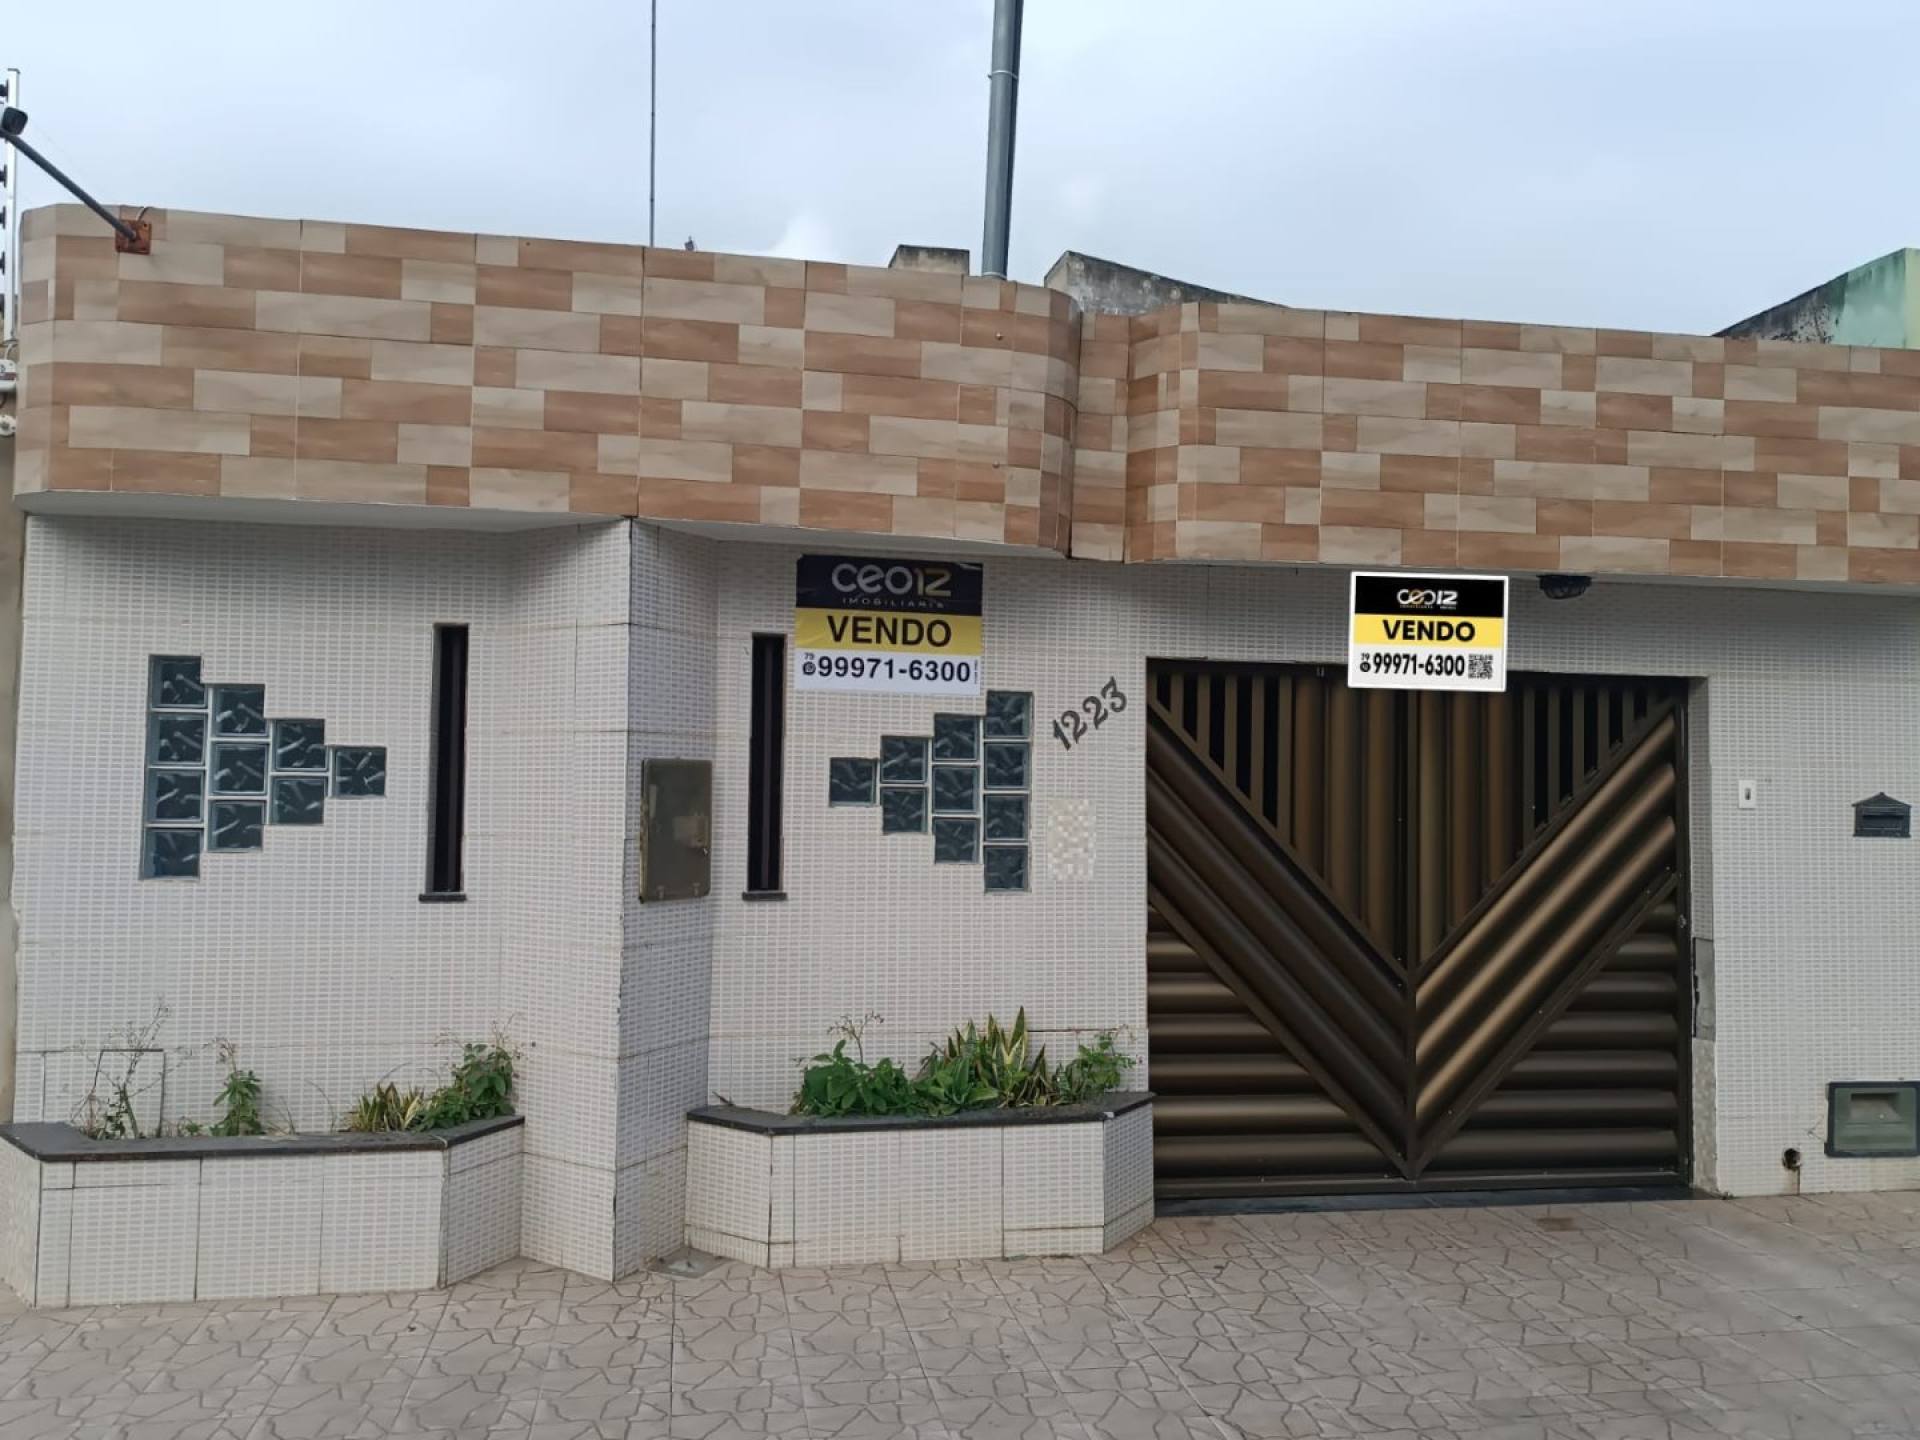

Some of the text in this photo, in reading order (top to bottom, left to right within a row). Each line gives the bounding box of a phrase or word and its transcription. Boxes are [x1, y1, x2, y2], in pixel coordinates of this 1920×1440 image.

[827, 615, 952, 648] VENDO
[1383, 619, 1476, 642] VENDO
[818, 656, 970, 682] 99971-6300
[1373, 652, 1465, 676] 99971-6300
[1053, 675, 1127, 751] 1223
